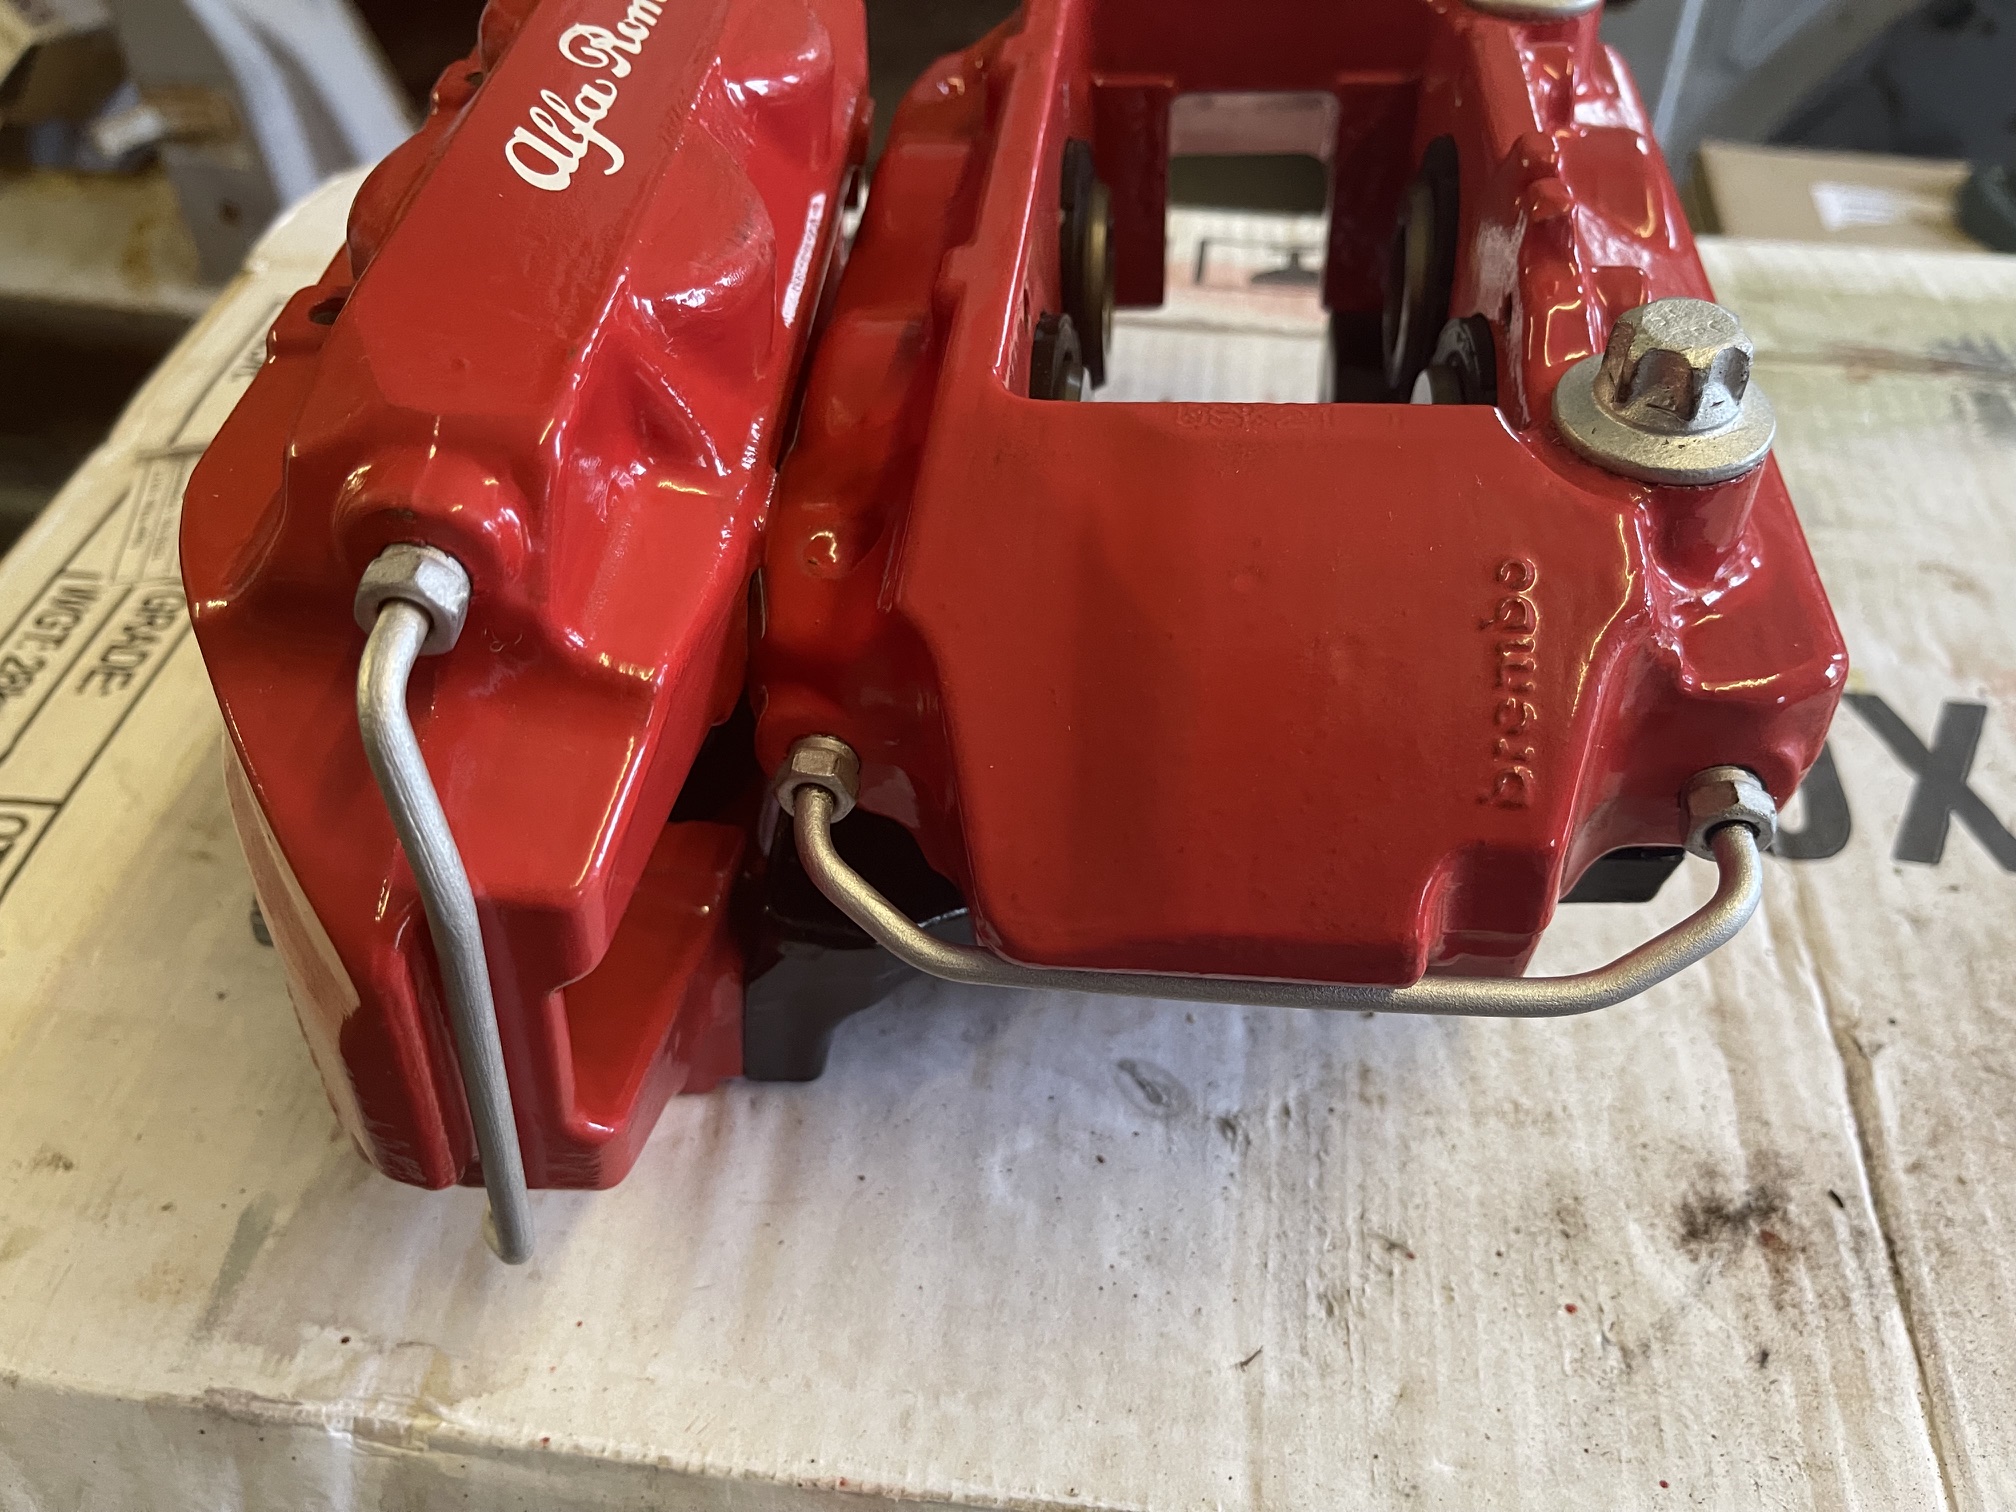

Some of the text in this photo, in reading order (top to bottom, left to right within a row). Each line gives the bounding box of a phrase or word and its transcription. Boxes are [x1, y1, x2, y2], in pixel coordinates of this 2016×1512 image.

[505, 79, 625, 191] Alfa
[76, 589, 187, 697] GRADE
[1474, 557, 1540, 810] brembo
